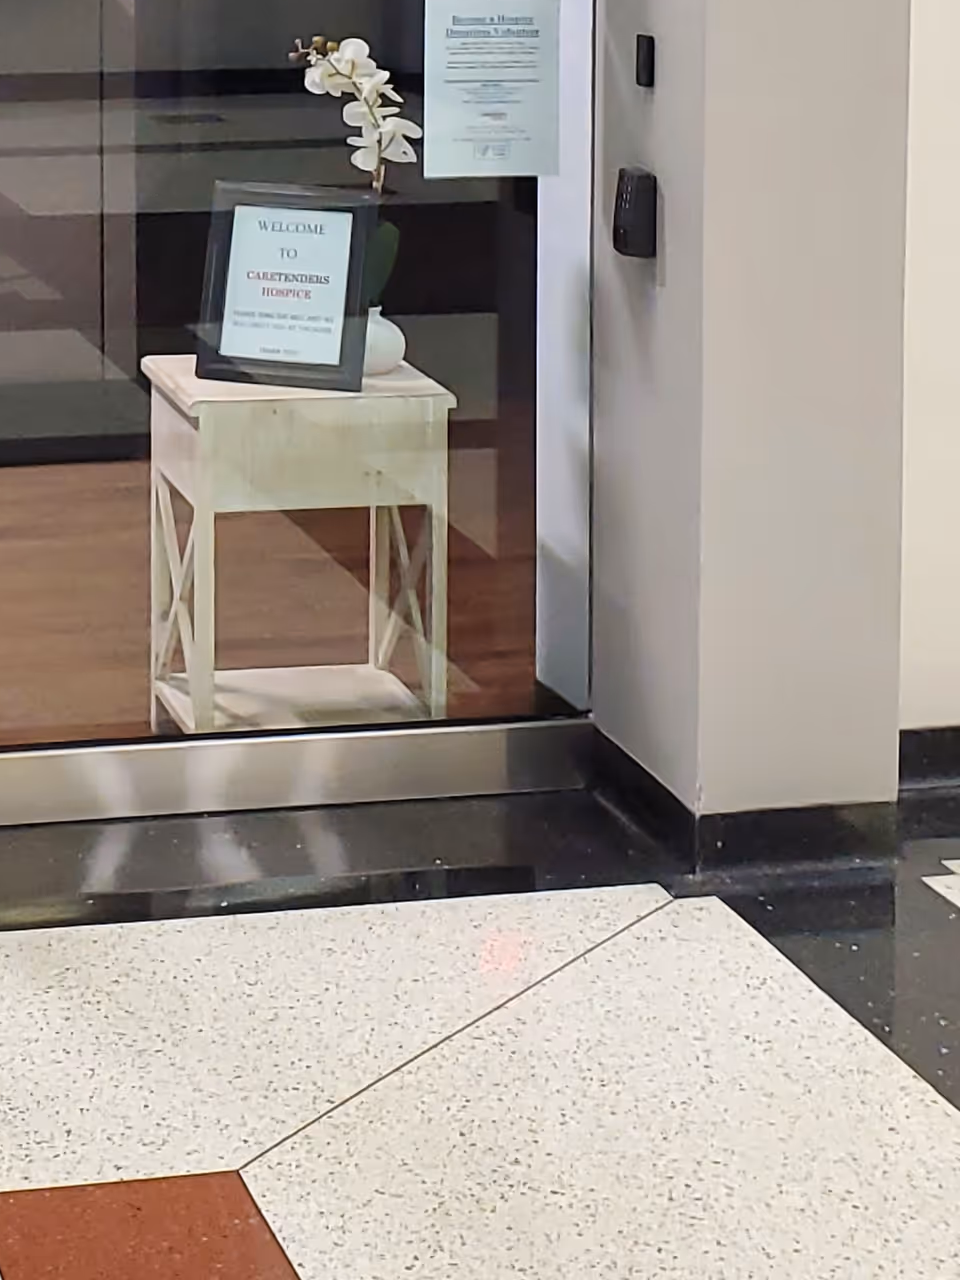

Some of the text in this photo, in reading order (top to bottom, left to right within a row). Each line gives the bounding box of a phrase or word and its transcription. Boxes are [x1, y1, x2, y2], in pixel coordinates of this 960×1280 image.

[257, 219, 326, 235] WELCOME
[279, 247, 298, 260] TO
[246, 270, 330, 285] CARETENDERS
[261, 286, 312, 300] HOSPICE
